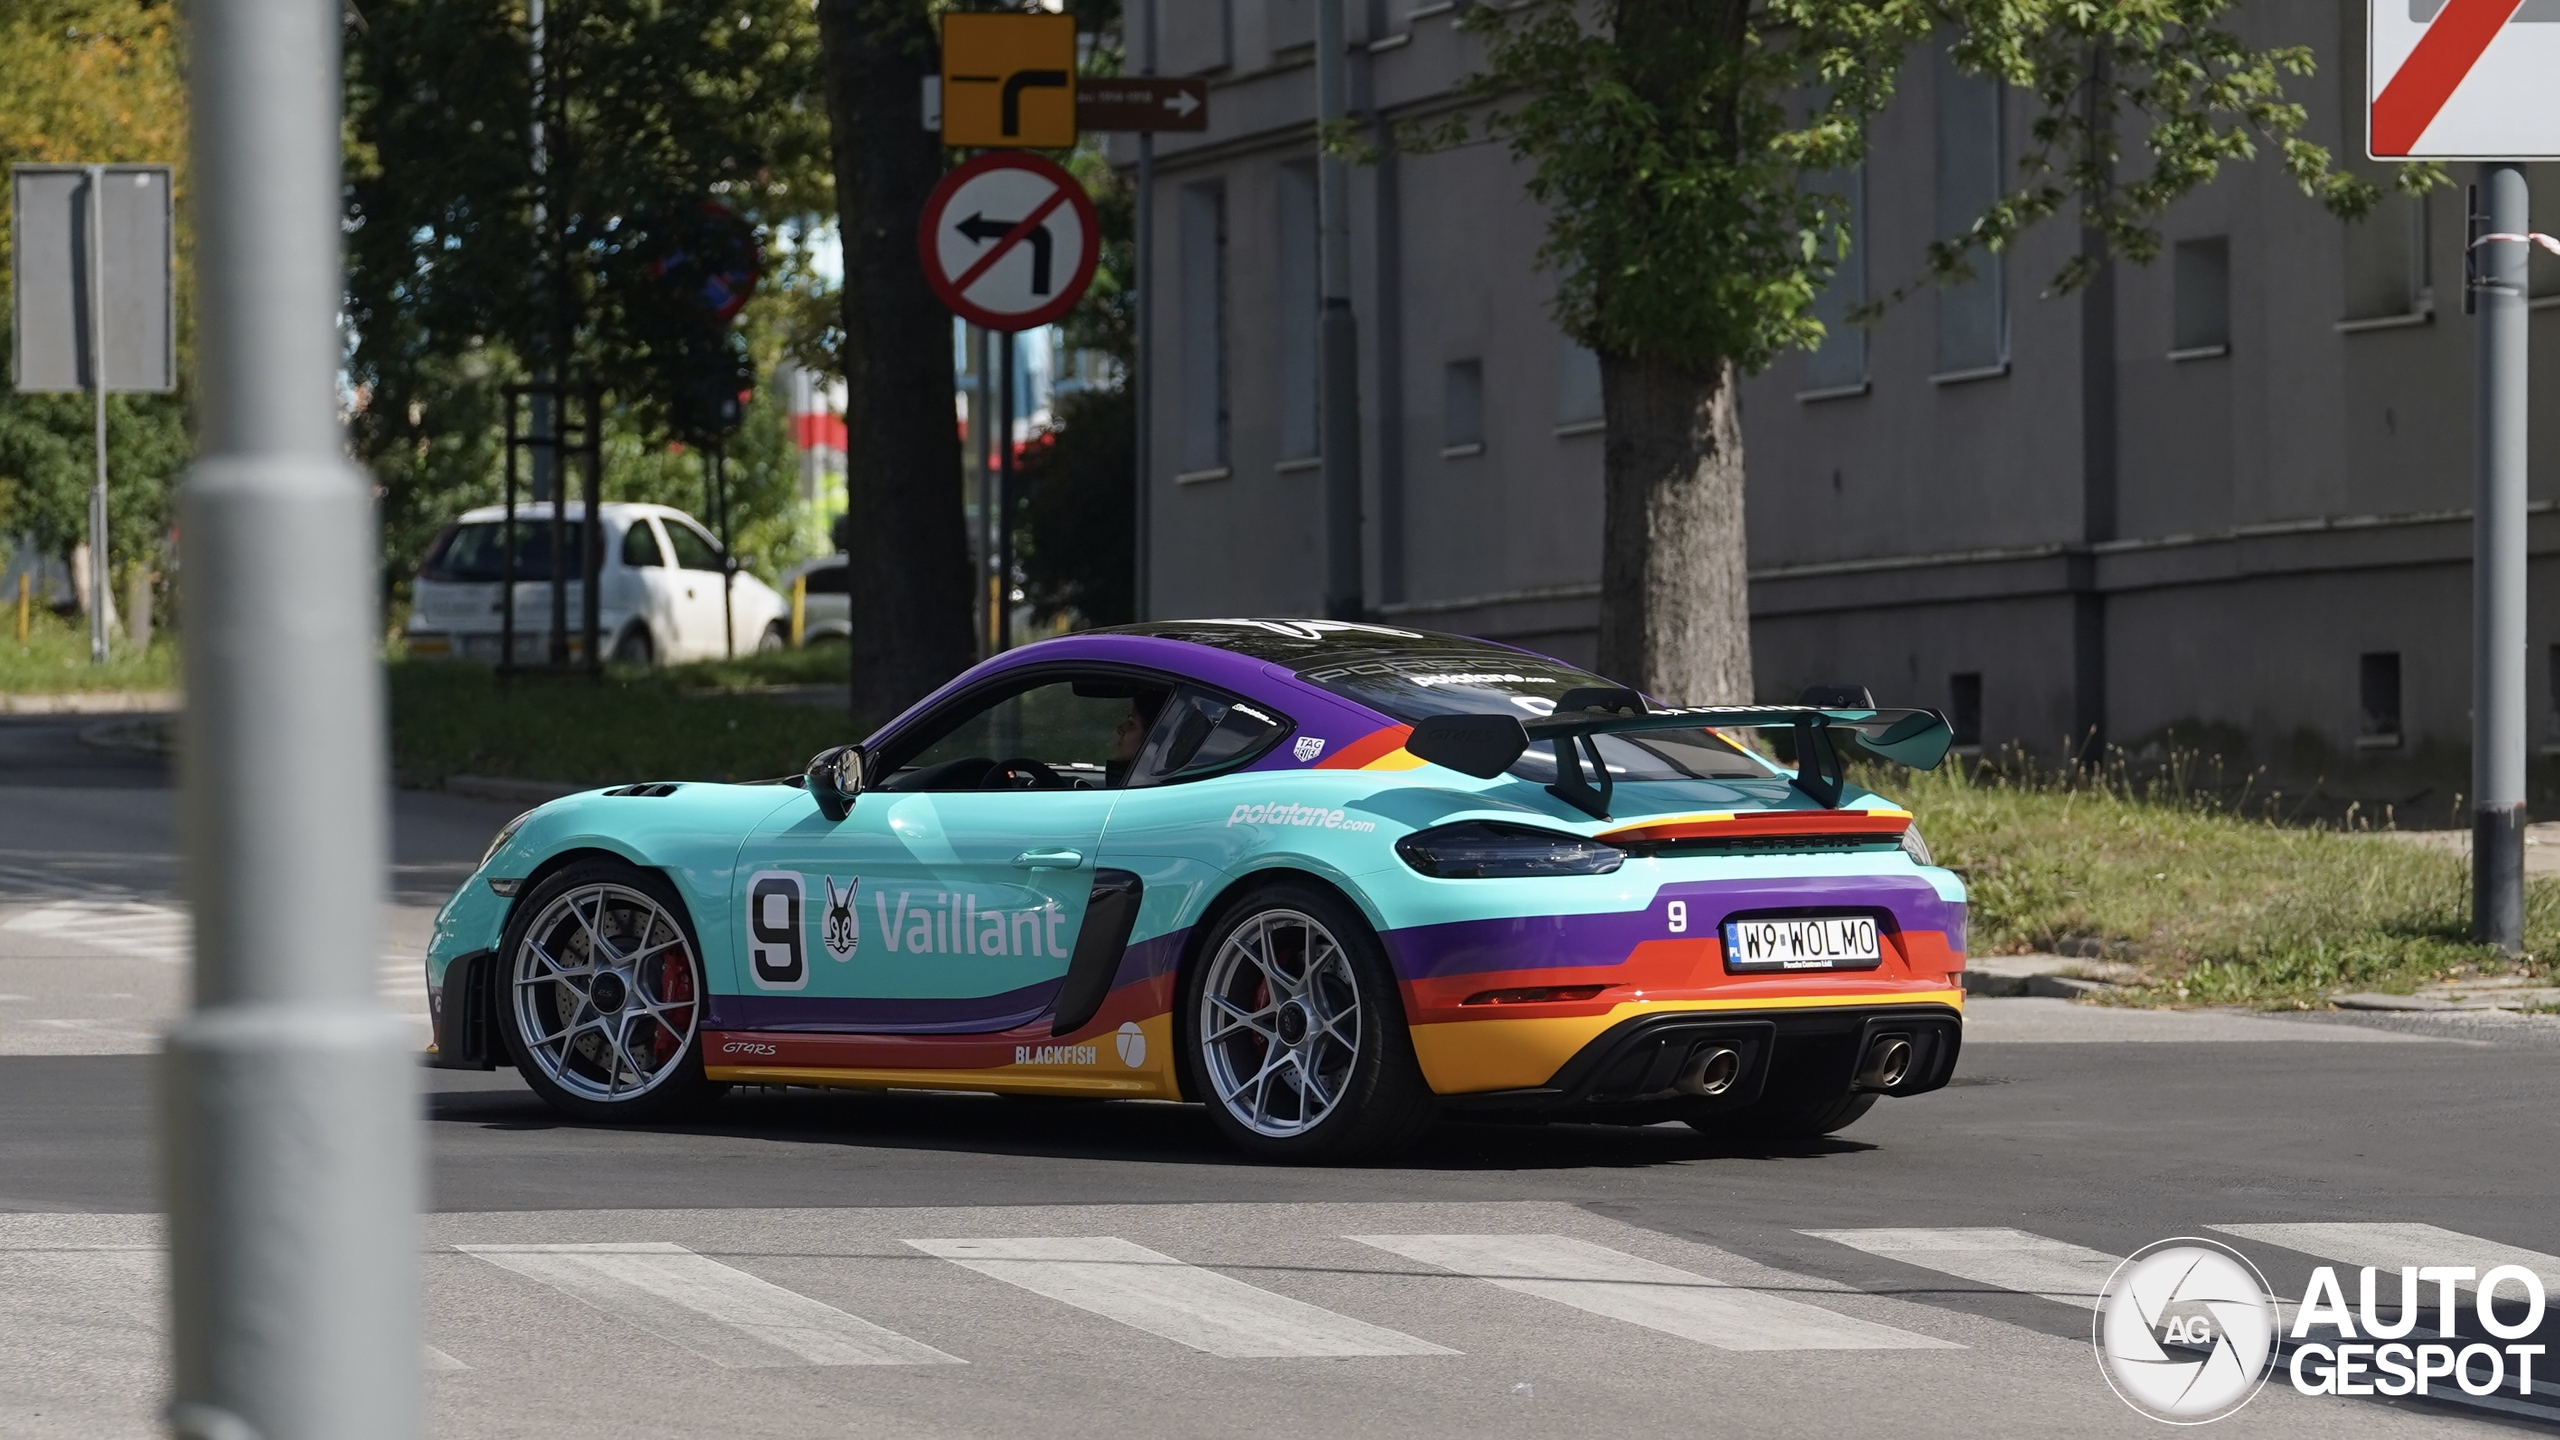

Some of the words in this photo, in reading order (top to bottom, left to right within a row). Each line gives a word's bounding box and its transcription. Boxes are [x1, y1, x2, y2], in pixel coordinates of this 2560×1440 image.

[1300, 738, 1322, 750] TAG
[1225, 801, 1376, 833] polatane.com
[752, 877, 803, 983] 9
[874, 890, 1068, 959] Vaillant
[1667, 900, 1688, 933] 9
[1729, 946, 1741, 958] PL
[1744, 923, 1777, 959] W9
[1788, 920, 1875, 957] WOLMO
[722, 1042, 777, 1055] GT4RS
[1015, 1045, 1097, 1065] BLACKFISH
